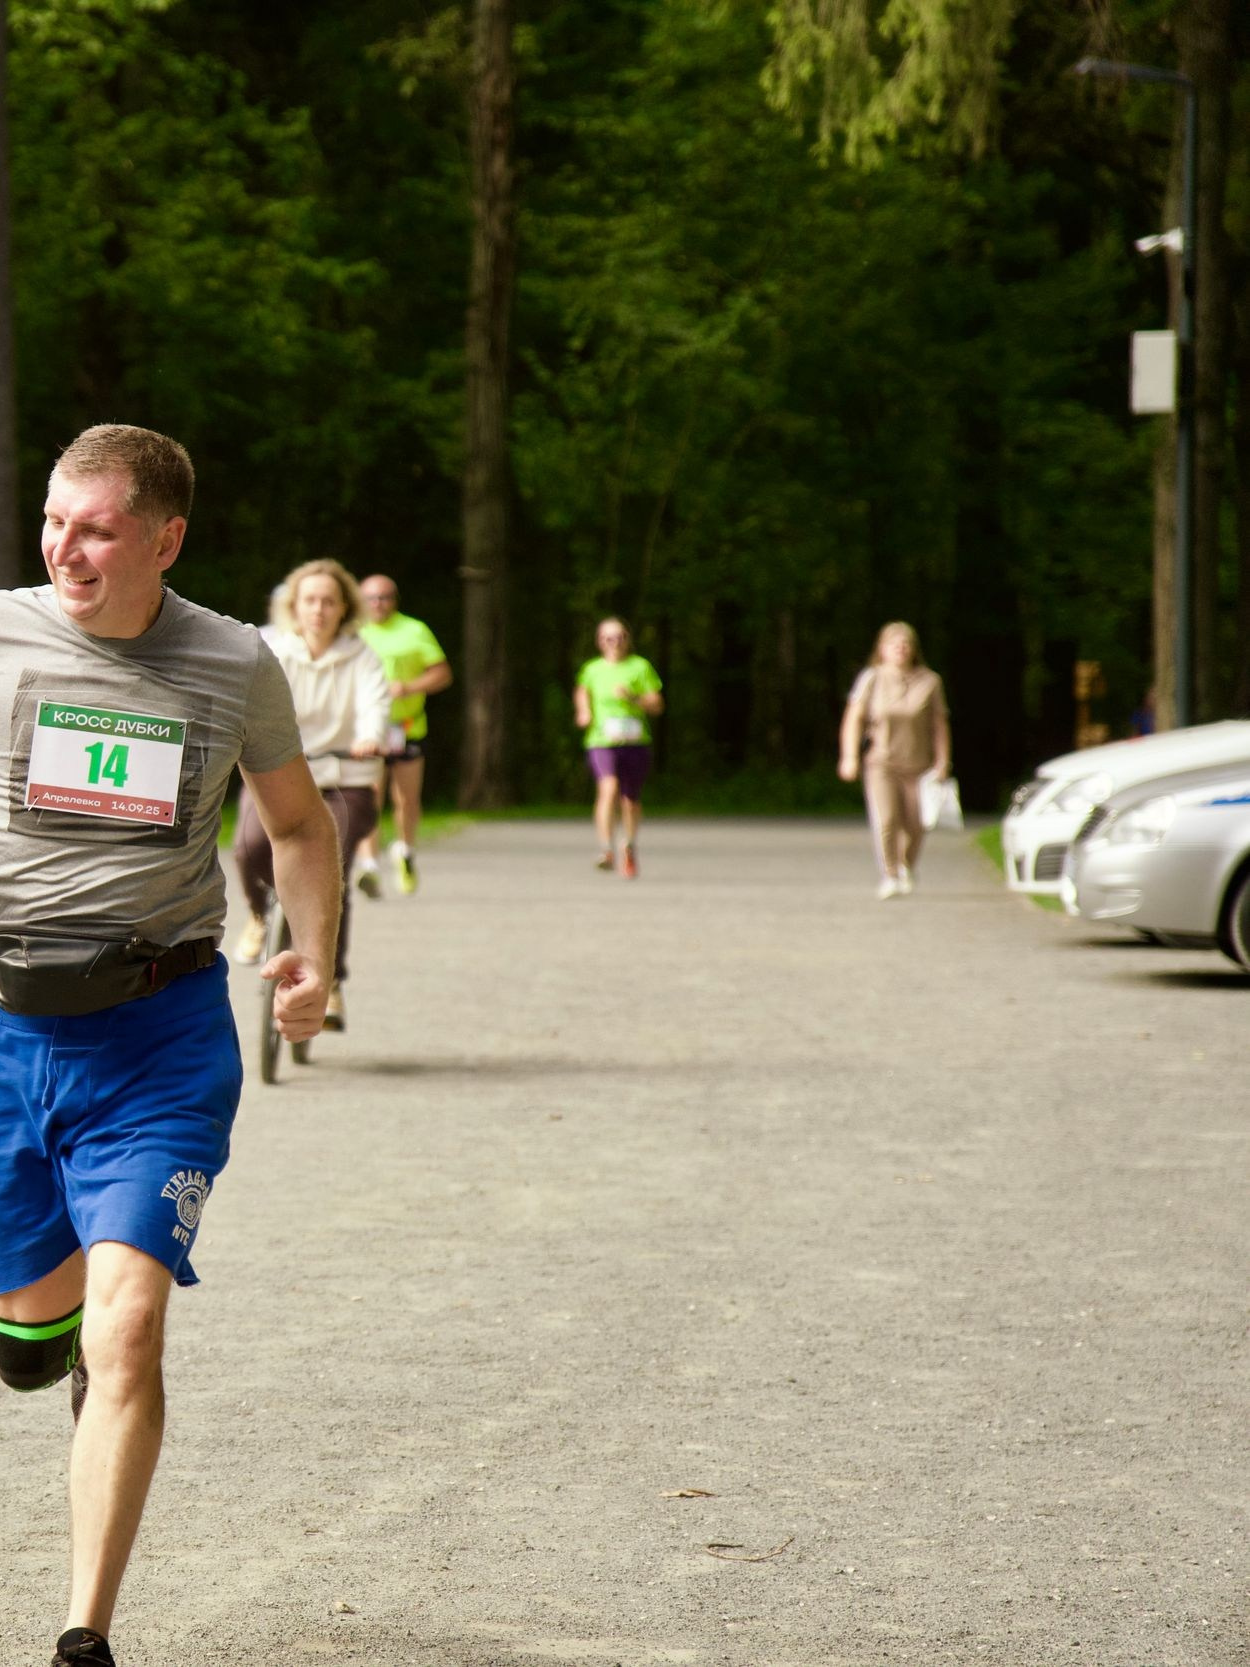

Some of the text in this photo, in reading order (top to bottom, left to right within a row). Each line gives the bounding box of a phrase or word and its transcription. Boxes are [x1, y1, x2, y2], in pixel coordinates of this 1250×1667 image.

[53, 710, 170, 738] КРОСС ДУБКИ
[84, 741, 130, 788] 14
[42, 792, 160, 816] Апрелевка 14.09.25
[171, 1224, 190, 1247] NYC
